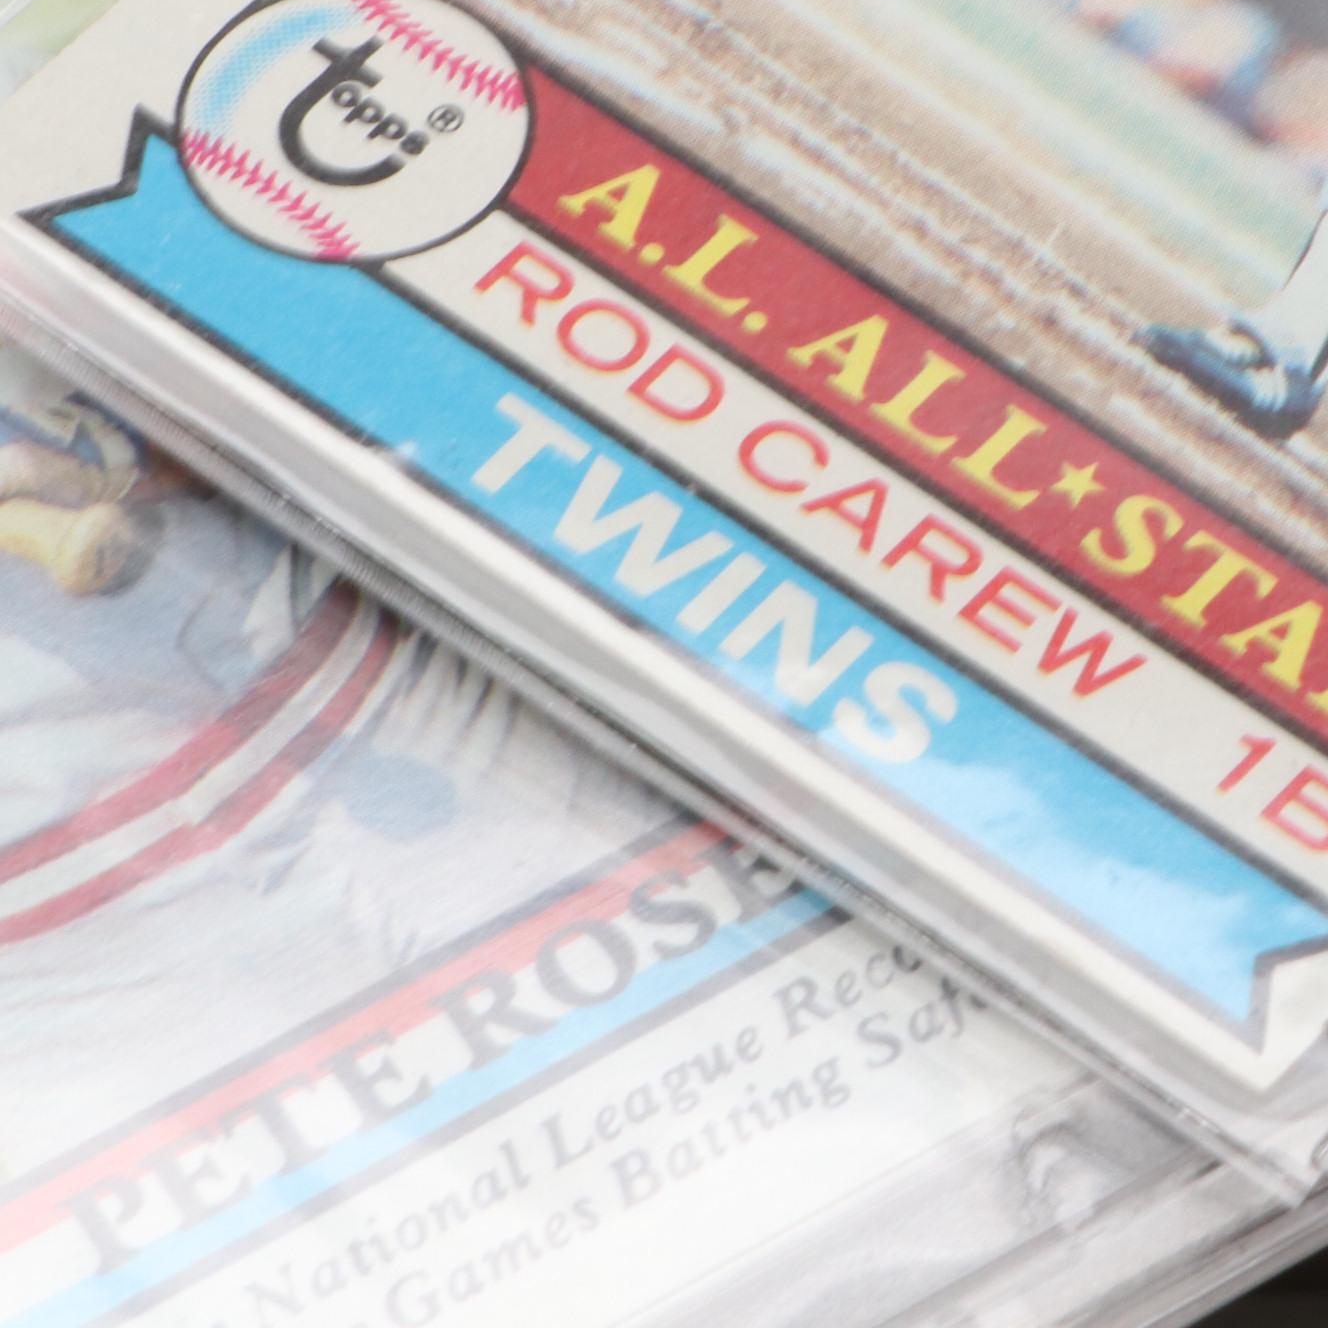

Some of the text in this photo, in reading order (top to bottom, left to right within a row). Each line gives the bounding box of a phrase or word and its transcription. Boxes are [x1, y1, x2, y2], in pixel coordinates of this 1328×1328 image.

[556, 163, 770, 333] A.L.
[469, 390, 958, 765] TWINS
[473, 239, 726, 424] ROD
[736, 419, 1149, 702] CAREW
[62, 1028, 434, 1276] PETE
[244, 1138, 532, 1320] National
[540, 1022, 765, 1172] League
[385, 1194, 603, 1328] Games
[608, 1051, 853, 1211] Batting
